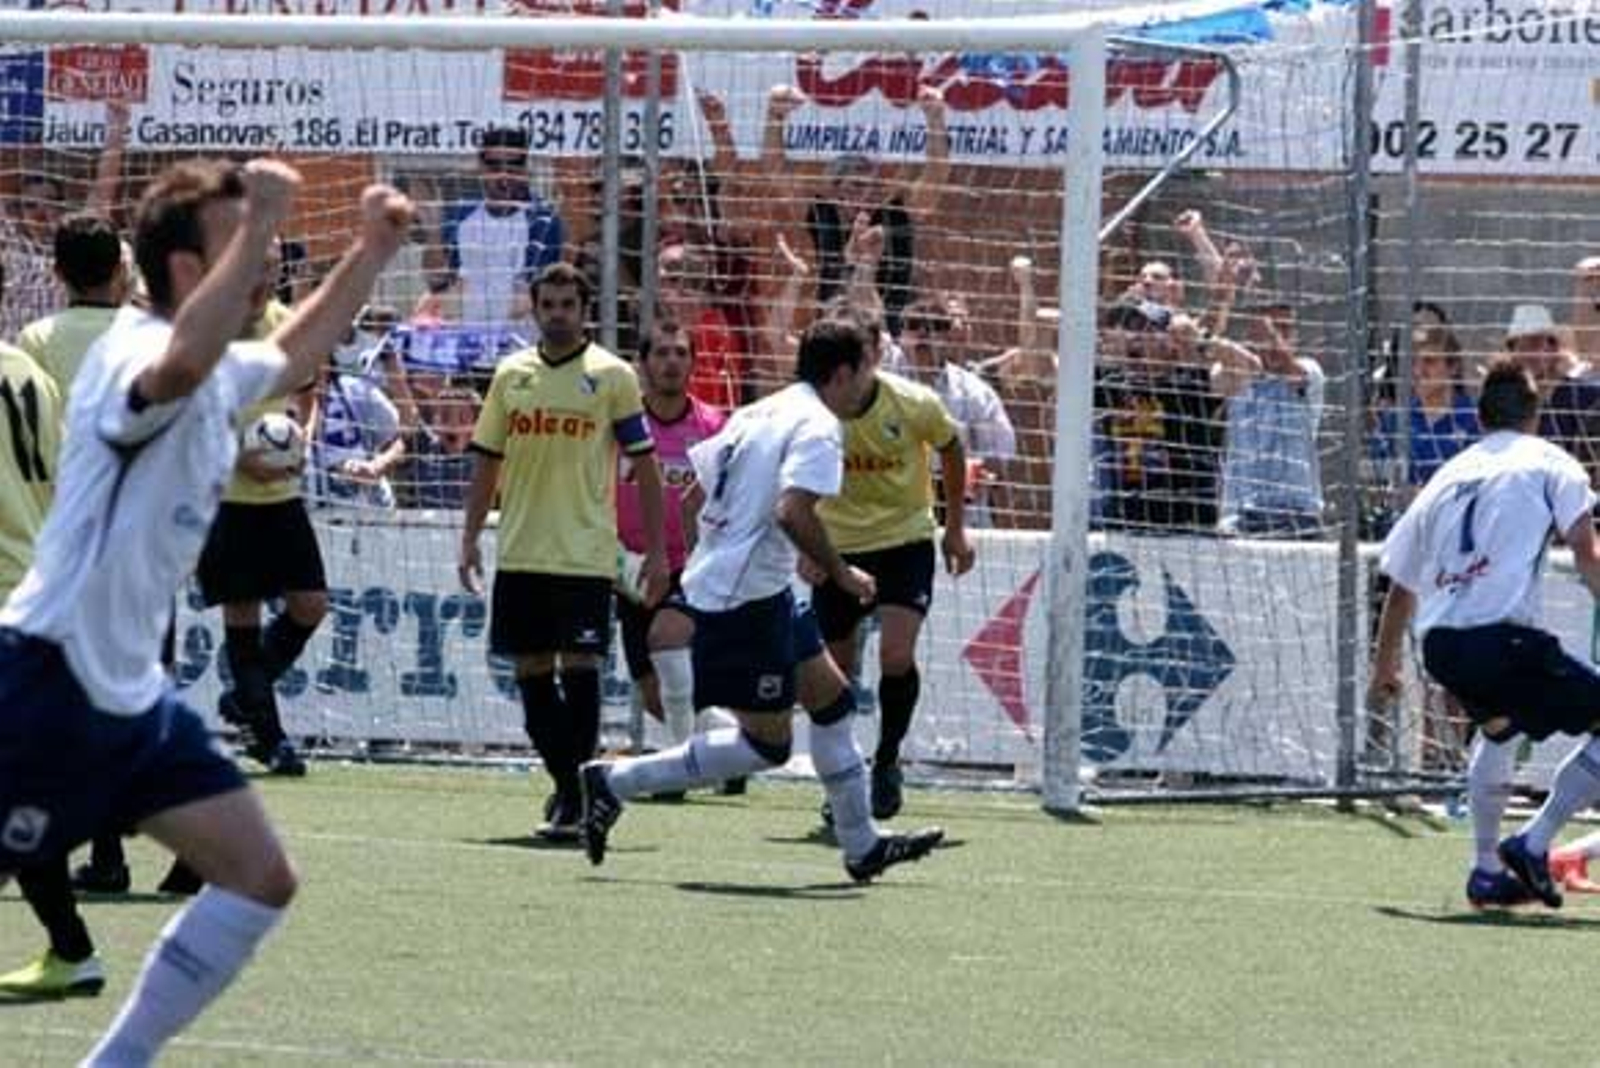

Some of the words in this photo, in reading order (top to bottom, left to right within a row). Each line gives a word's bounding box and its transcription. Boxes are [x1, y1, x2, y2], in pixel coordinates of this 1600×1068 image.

[172, 62, 324, 117] Seguros
[294, 117, 342, 147] 186
[385, 120, 441, 148] Prat
[787, 123, 880, 153] LIMPIEZA
[1019, 124, 1036, 154] Y
[1454, 122, 1508, 160] 25
[1523, 122, 1581, 159] 27
[0, 378, 48, 482] 11
[1454, 477, 1486, 555] 7
